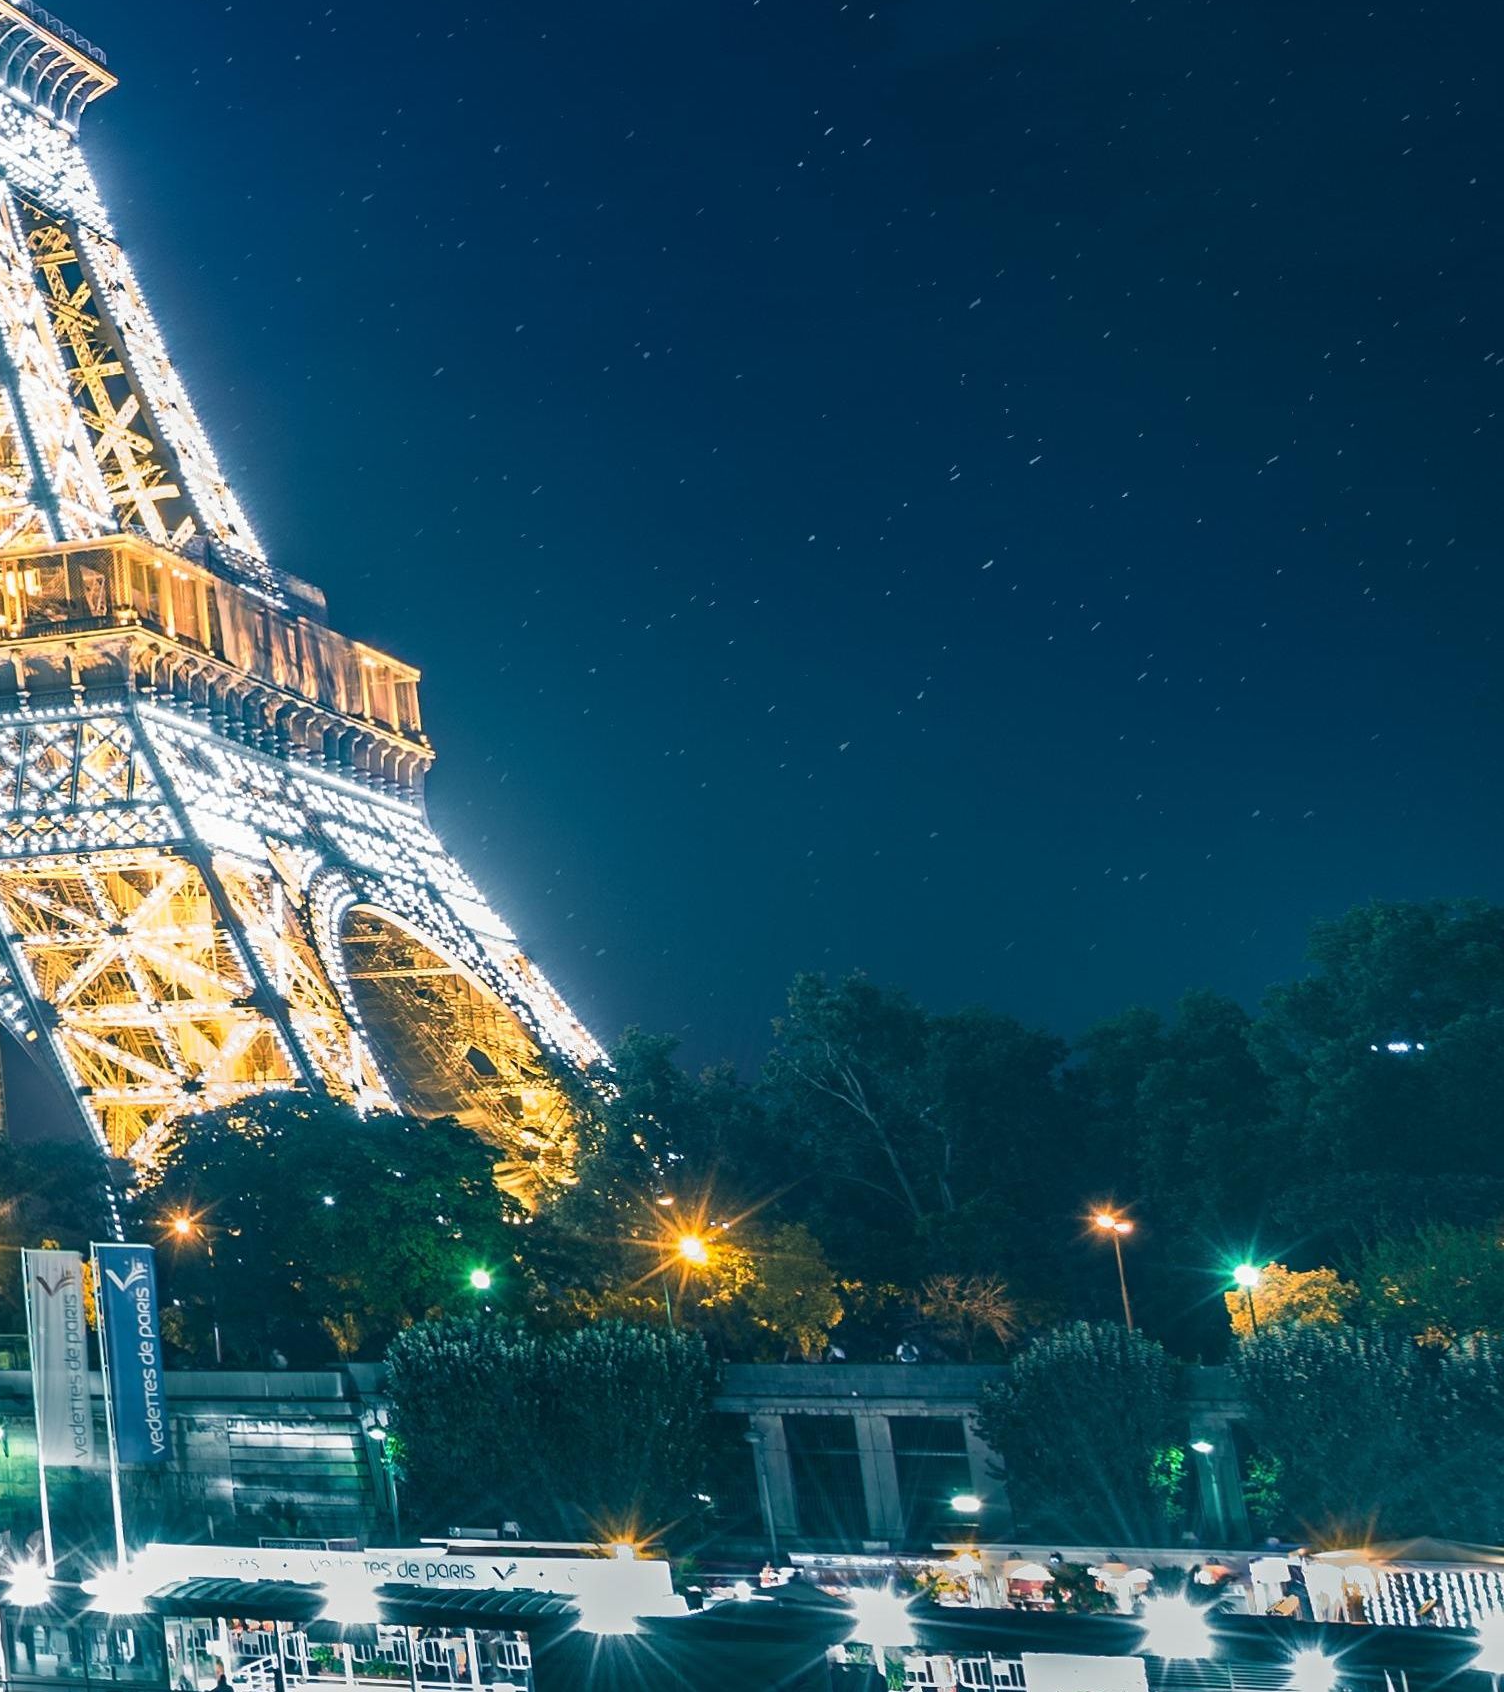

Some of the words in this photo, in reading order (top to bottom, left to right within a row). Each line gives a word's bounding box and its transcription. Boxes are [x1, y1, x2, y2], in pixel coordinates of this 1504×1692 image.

[64, 1348, 82, 1371] de
[138, 1341, 155, 1365] de
[397, 1560, 420, 1579] de
